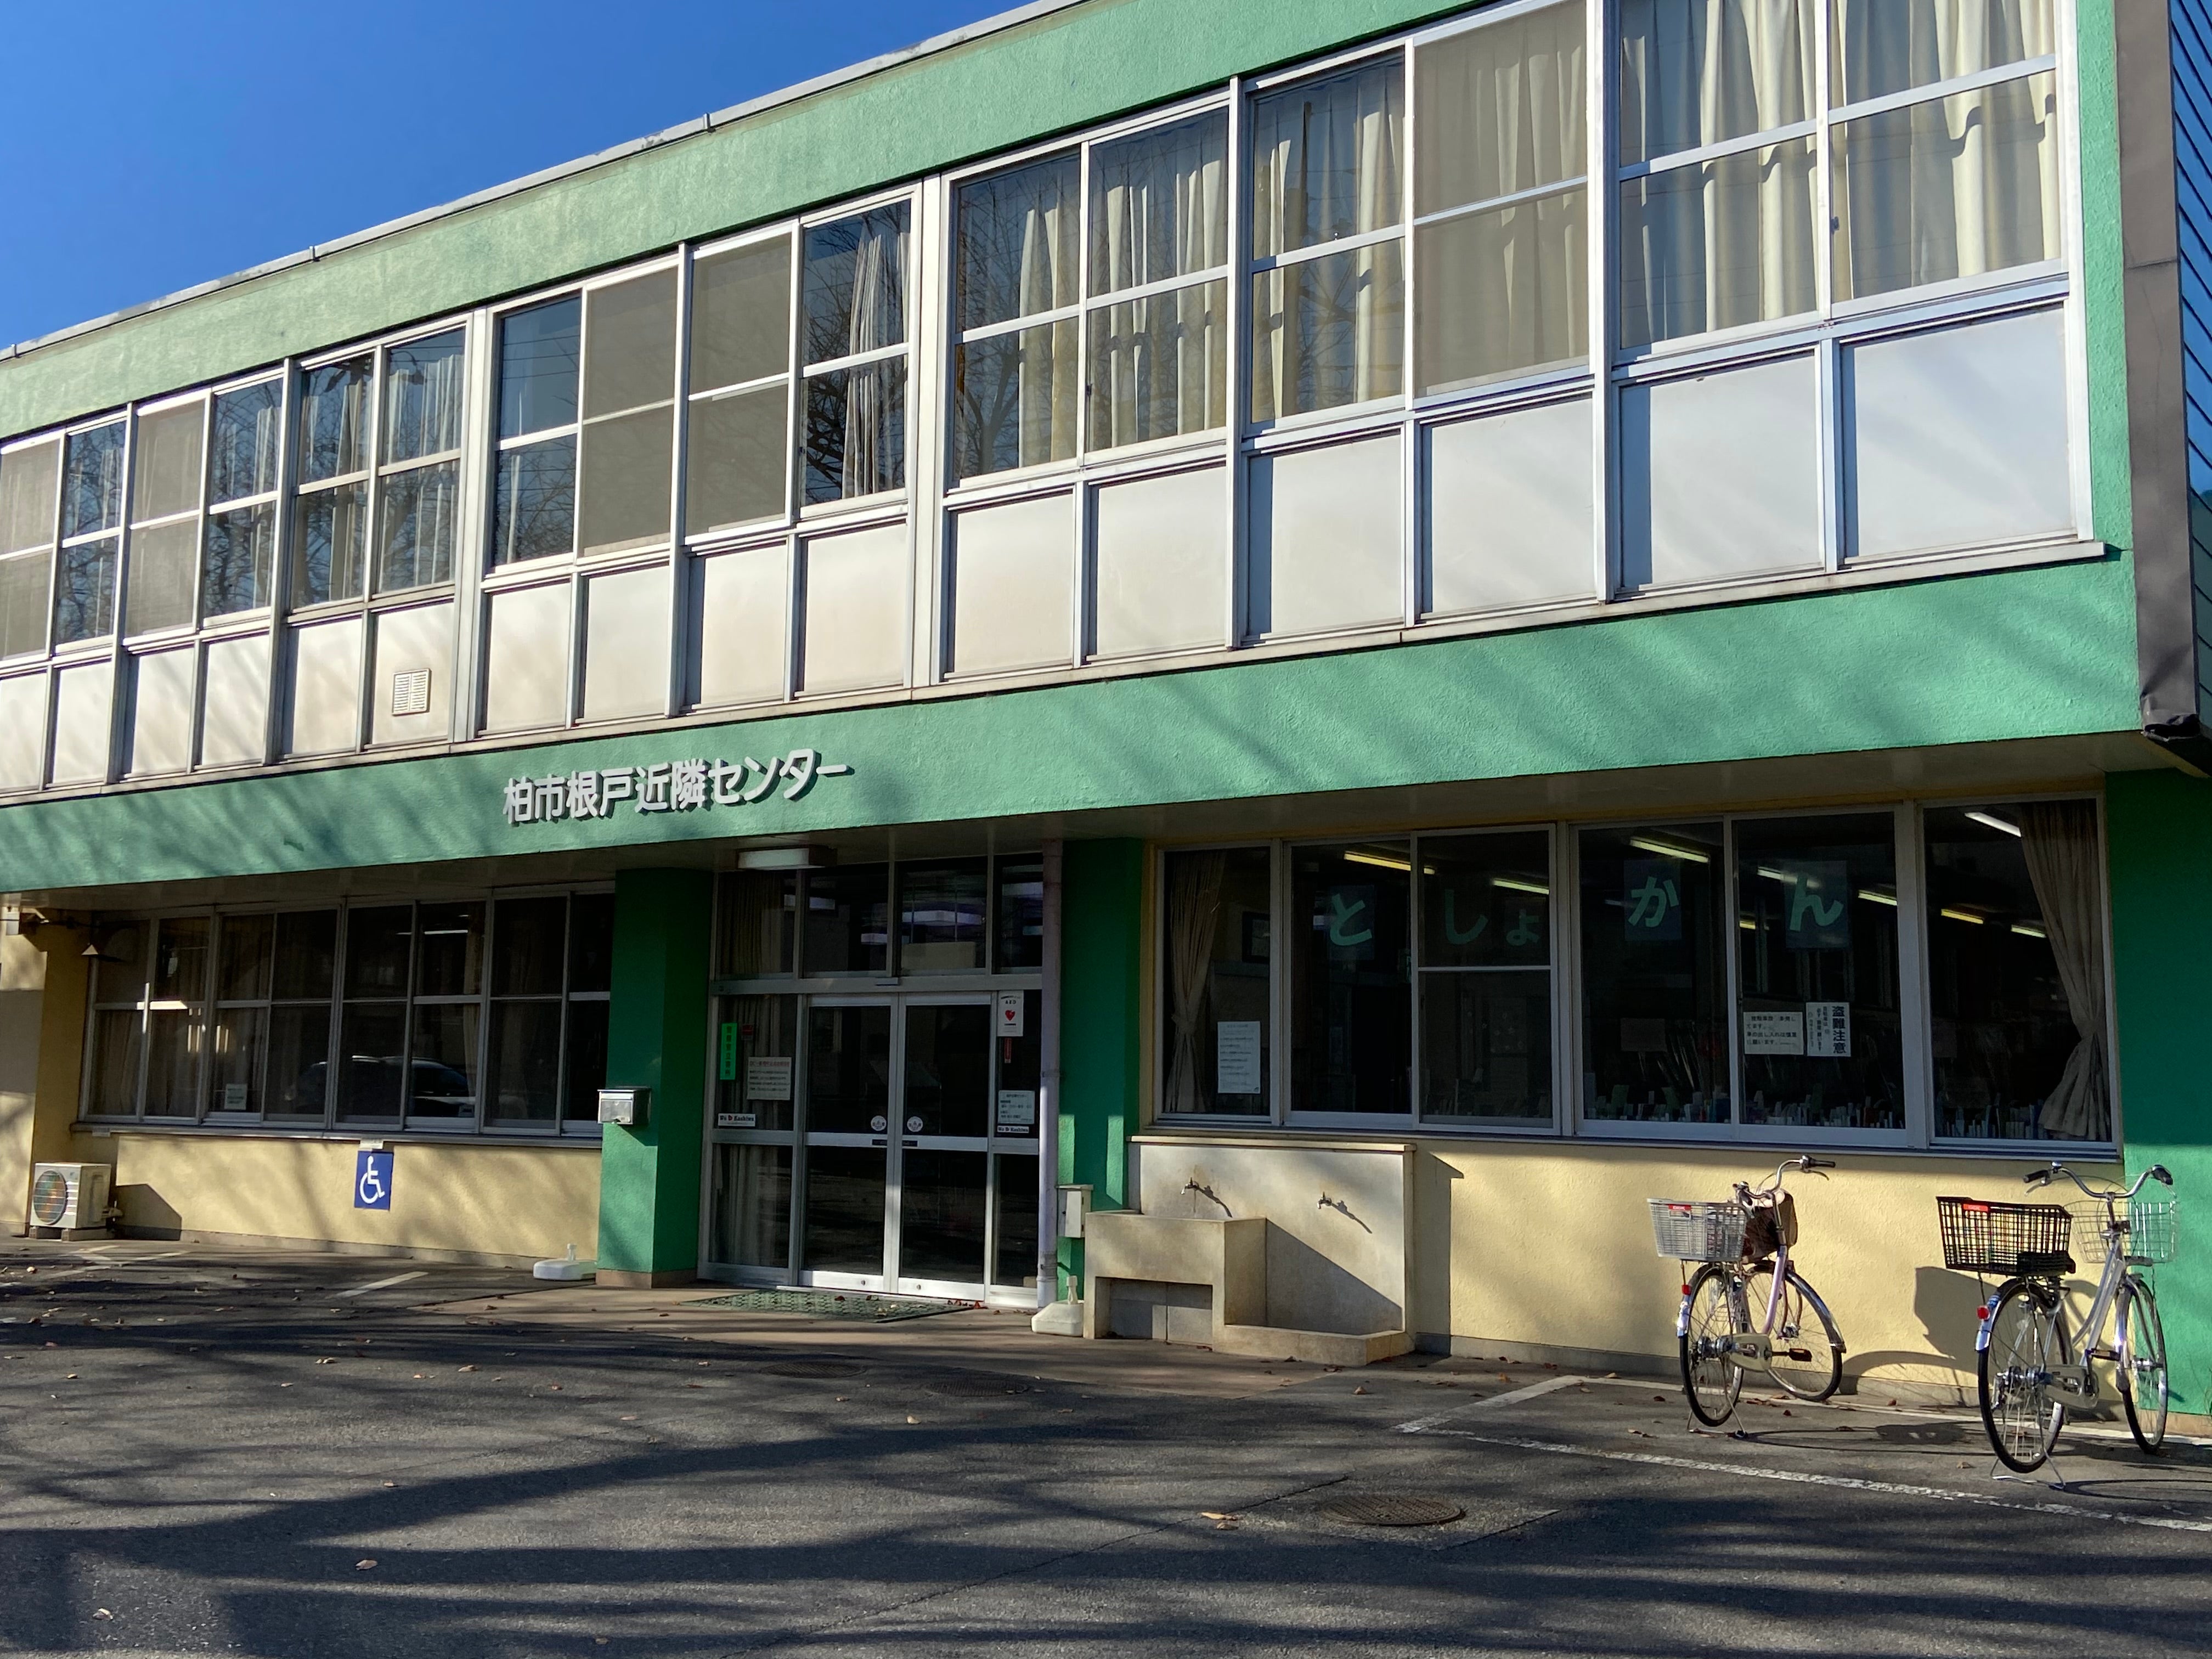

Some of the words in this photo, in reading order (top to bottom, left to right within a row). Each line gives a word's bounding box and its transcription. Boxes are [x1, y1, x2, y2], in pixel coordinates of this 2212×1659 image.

[503, 748, 850, 824] 柏市根戸近隣センター
[1329, 875, 1844, 946] としょかん
[1832, 1006, 1847, 1054] 盗難注意
